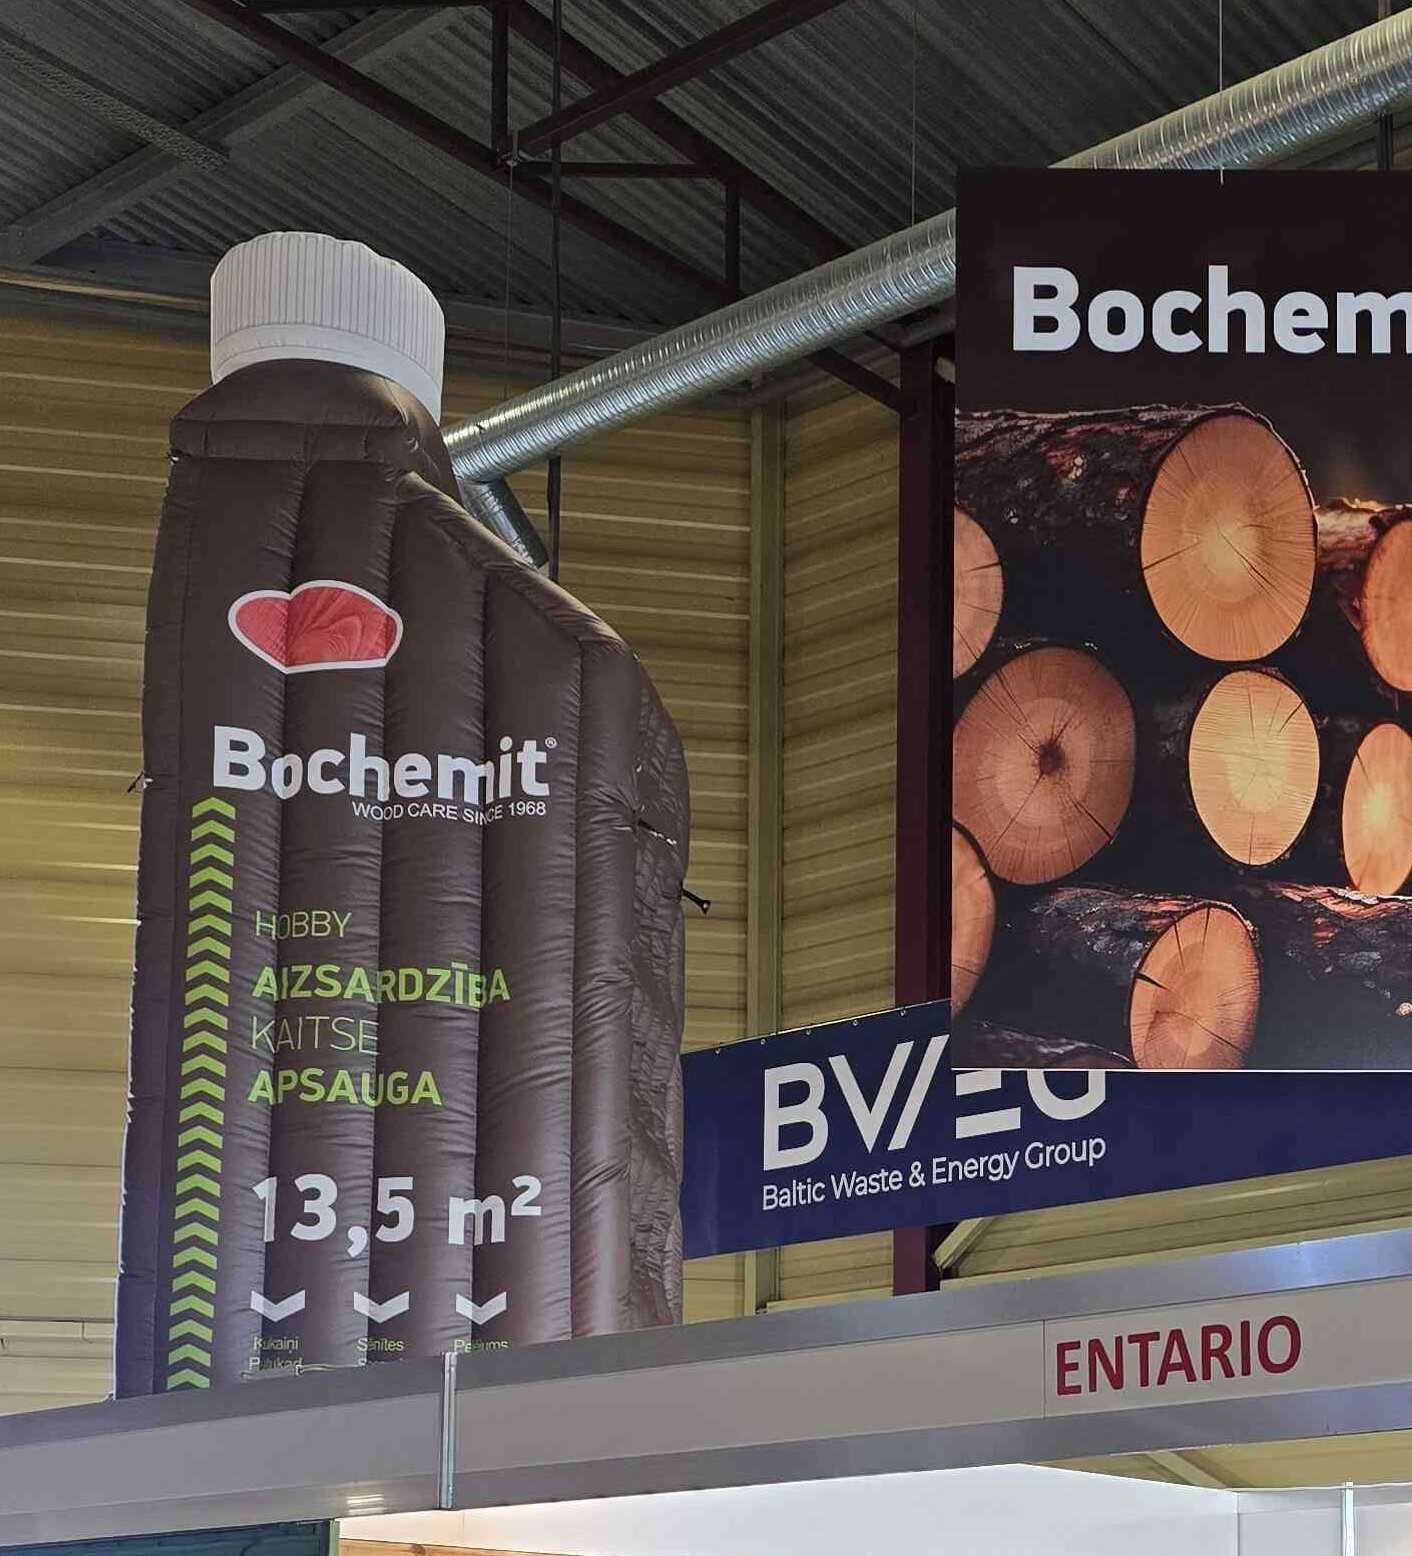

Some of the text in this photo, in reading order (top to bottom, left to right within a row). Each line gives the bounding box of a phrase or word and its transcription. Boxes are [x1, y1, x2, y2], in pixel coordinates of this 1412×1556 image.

[352, 800, 548, 826] WOOD CARE SINCE 1968
[256, 909, 352, 940] HOBBY
[252, 961, 511, 1009] AIZSARDZĪBA
[250, 1015, 380, 1056] KAITSE
[247, 1068, 443, 1107] APSAUGA
[762, 1135, 1107, 1211] Baltic Waste & Energy Group
[251, 1173, 415, 1258] 13,5
[1056, 1315, 1302, 1396] ENTARIO
